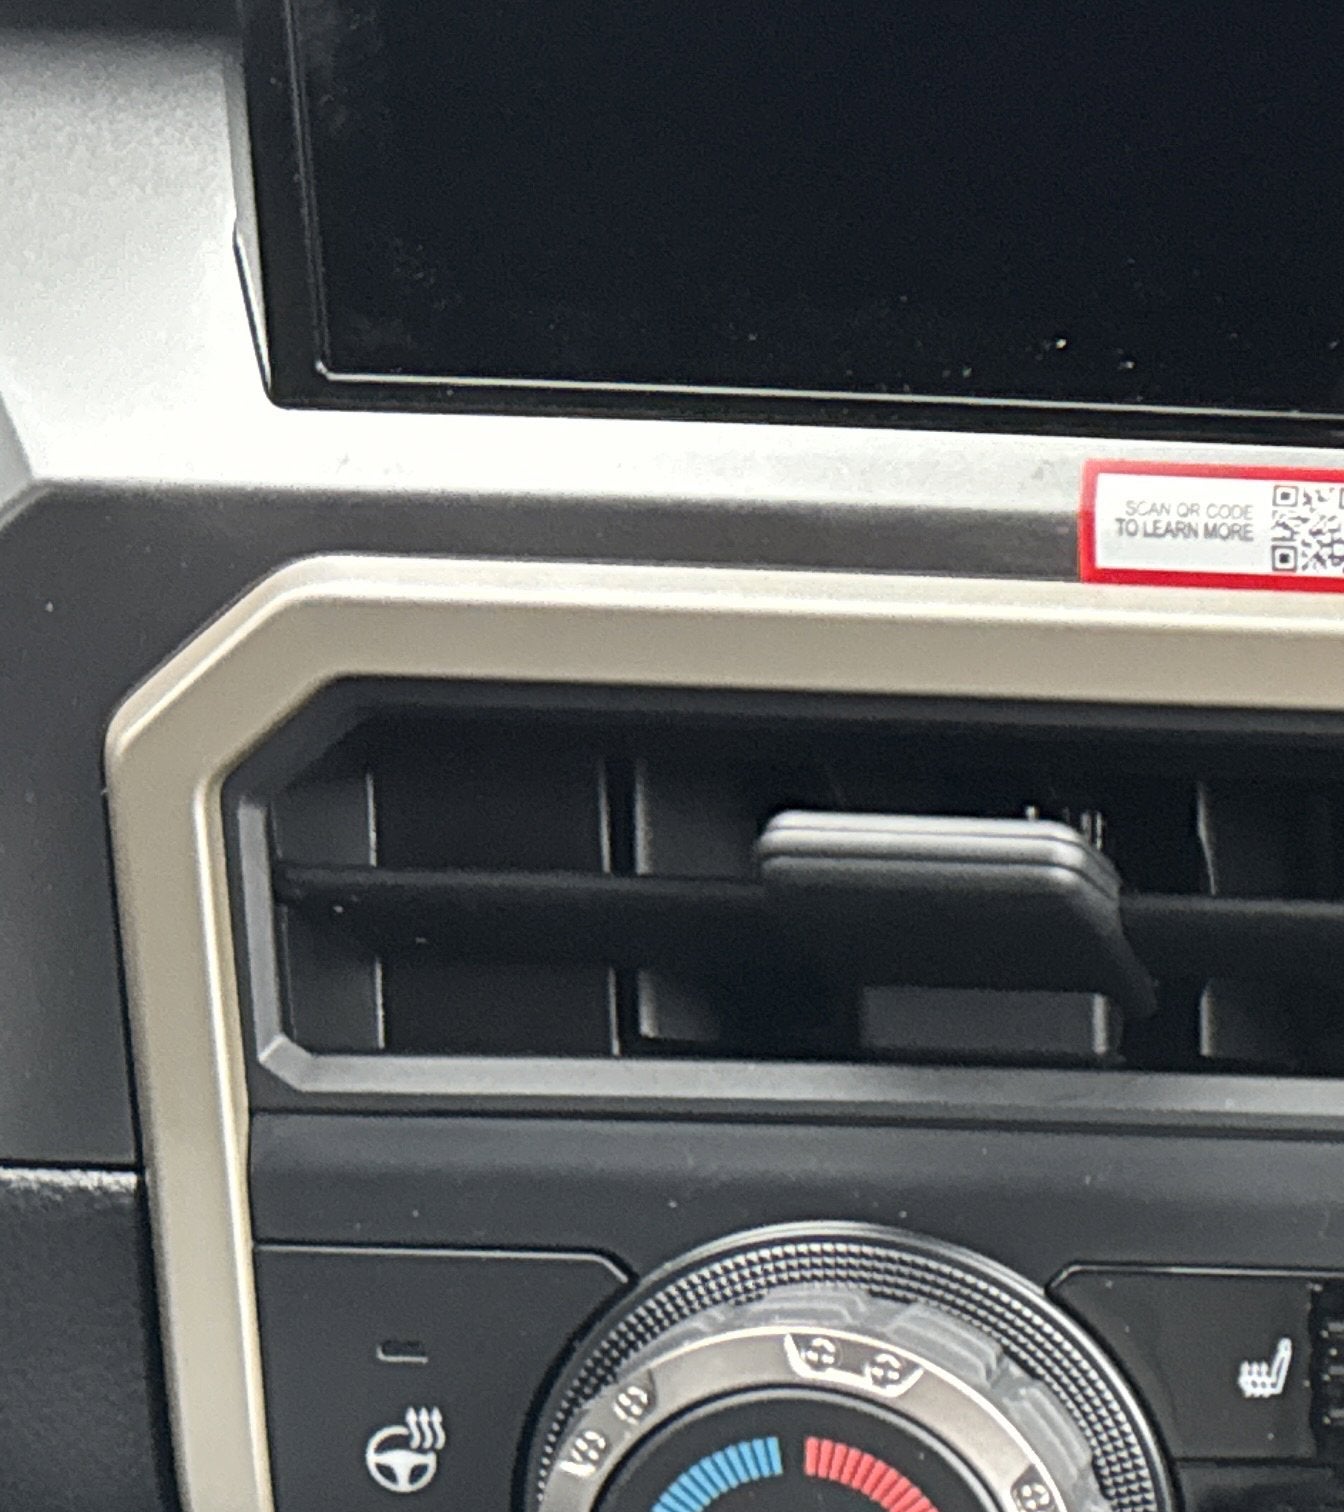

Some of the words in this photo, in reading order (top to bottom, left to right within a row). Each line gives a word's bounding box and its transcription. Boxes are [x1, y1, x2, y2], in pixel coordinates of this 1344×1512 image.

[1125, 500, 1171, 517] SCAN
[1176, 502, 1200, 518] QR
[1206, 503, 1254, 520] CODE
[1115, 518, 1139, 536] TO
[1143, 520, 1198, 539] LEARN
[1203, 522, 1255, 542] MORE
